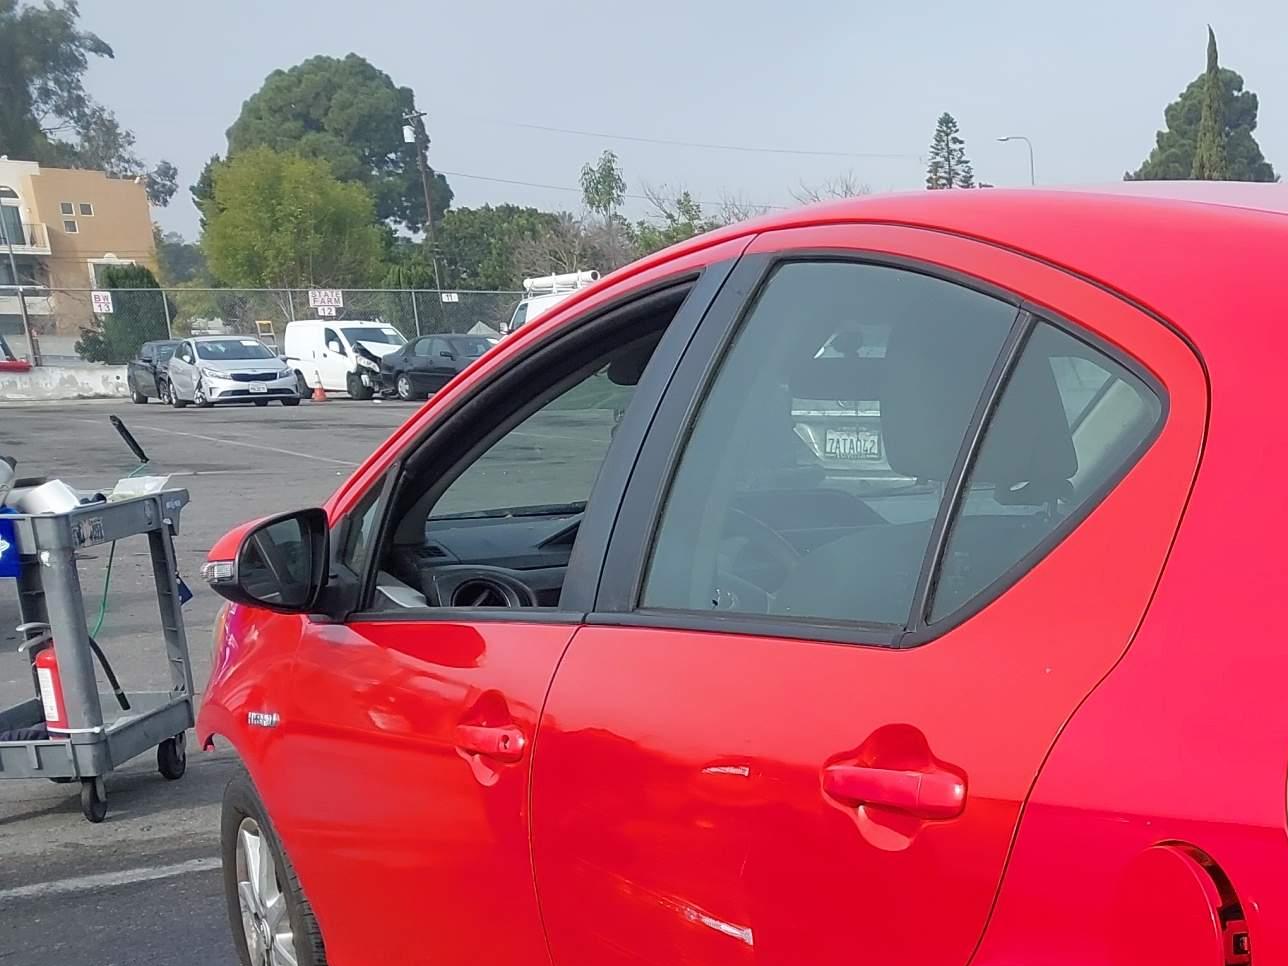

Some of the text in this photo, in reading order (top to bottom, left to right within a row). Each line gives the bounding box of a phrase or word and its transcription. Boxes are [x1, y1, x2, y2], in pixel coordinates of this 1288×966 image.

[94, 294, 110, 302] BW
[313, 297, 341, 305] FARM
[97, 302, 111, 312] 13
[319, 307, 334, 315] 12
